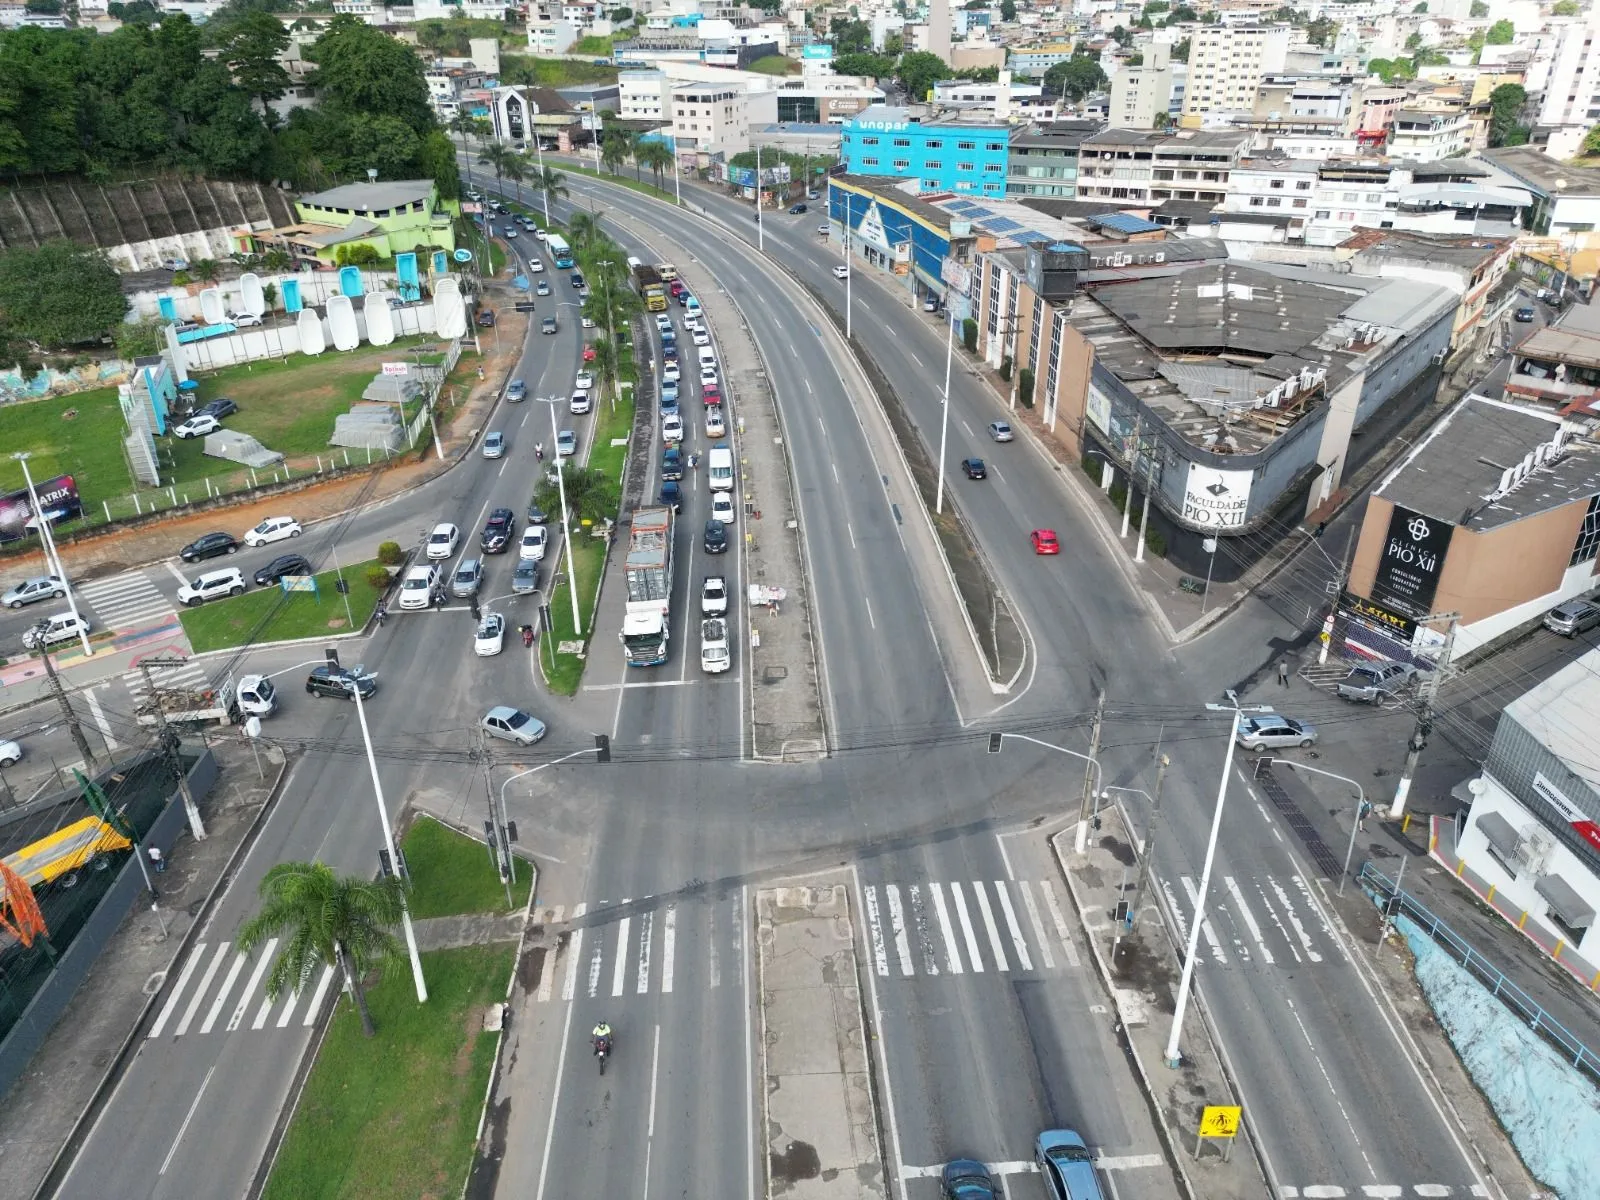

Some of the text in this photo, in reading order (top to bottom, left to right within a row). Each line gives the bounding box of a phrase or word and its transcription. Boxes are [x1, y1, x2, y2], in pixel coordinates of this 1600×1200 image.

[859, 120, 909, 133] unopar
[39, 486, 70, 505] ATRIX
[1187, 491, 1247, 510] FACULDADE
[1184, 503, 1244, 526] PIO XII
[1388, 543, 1435, 573] PIO XII
[1366, 606, 1407, 628] START
